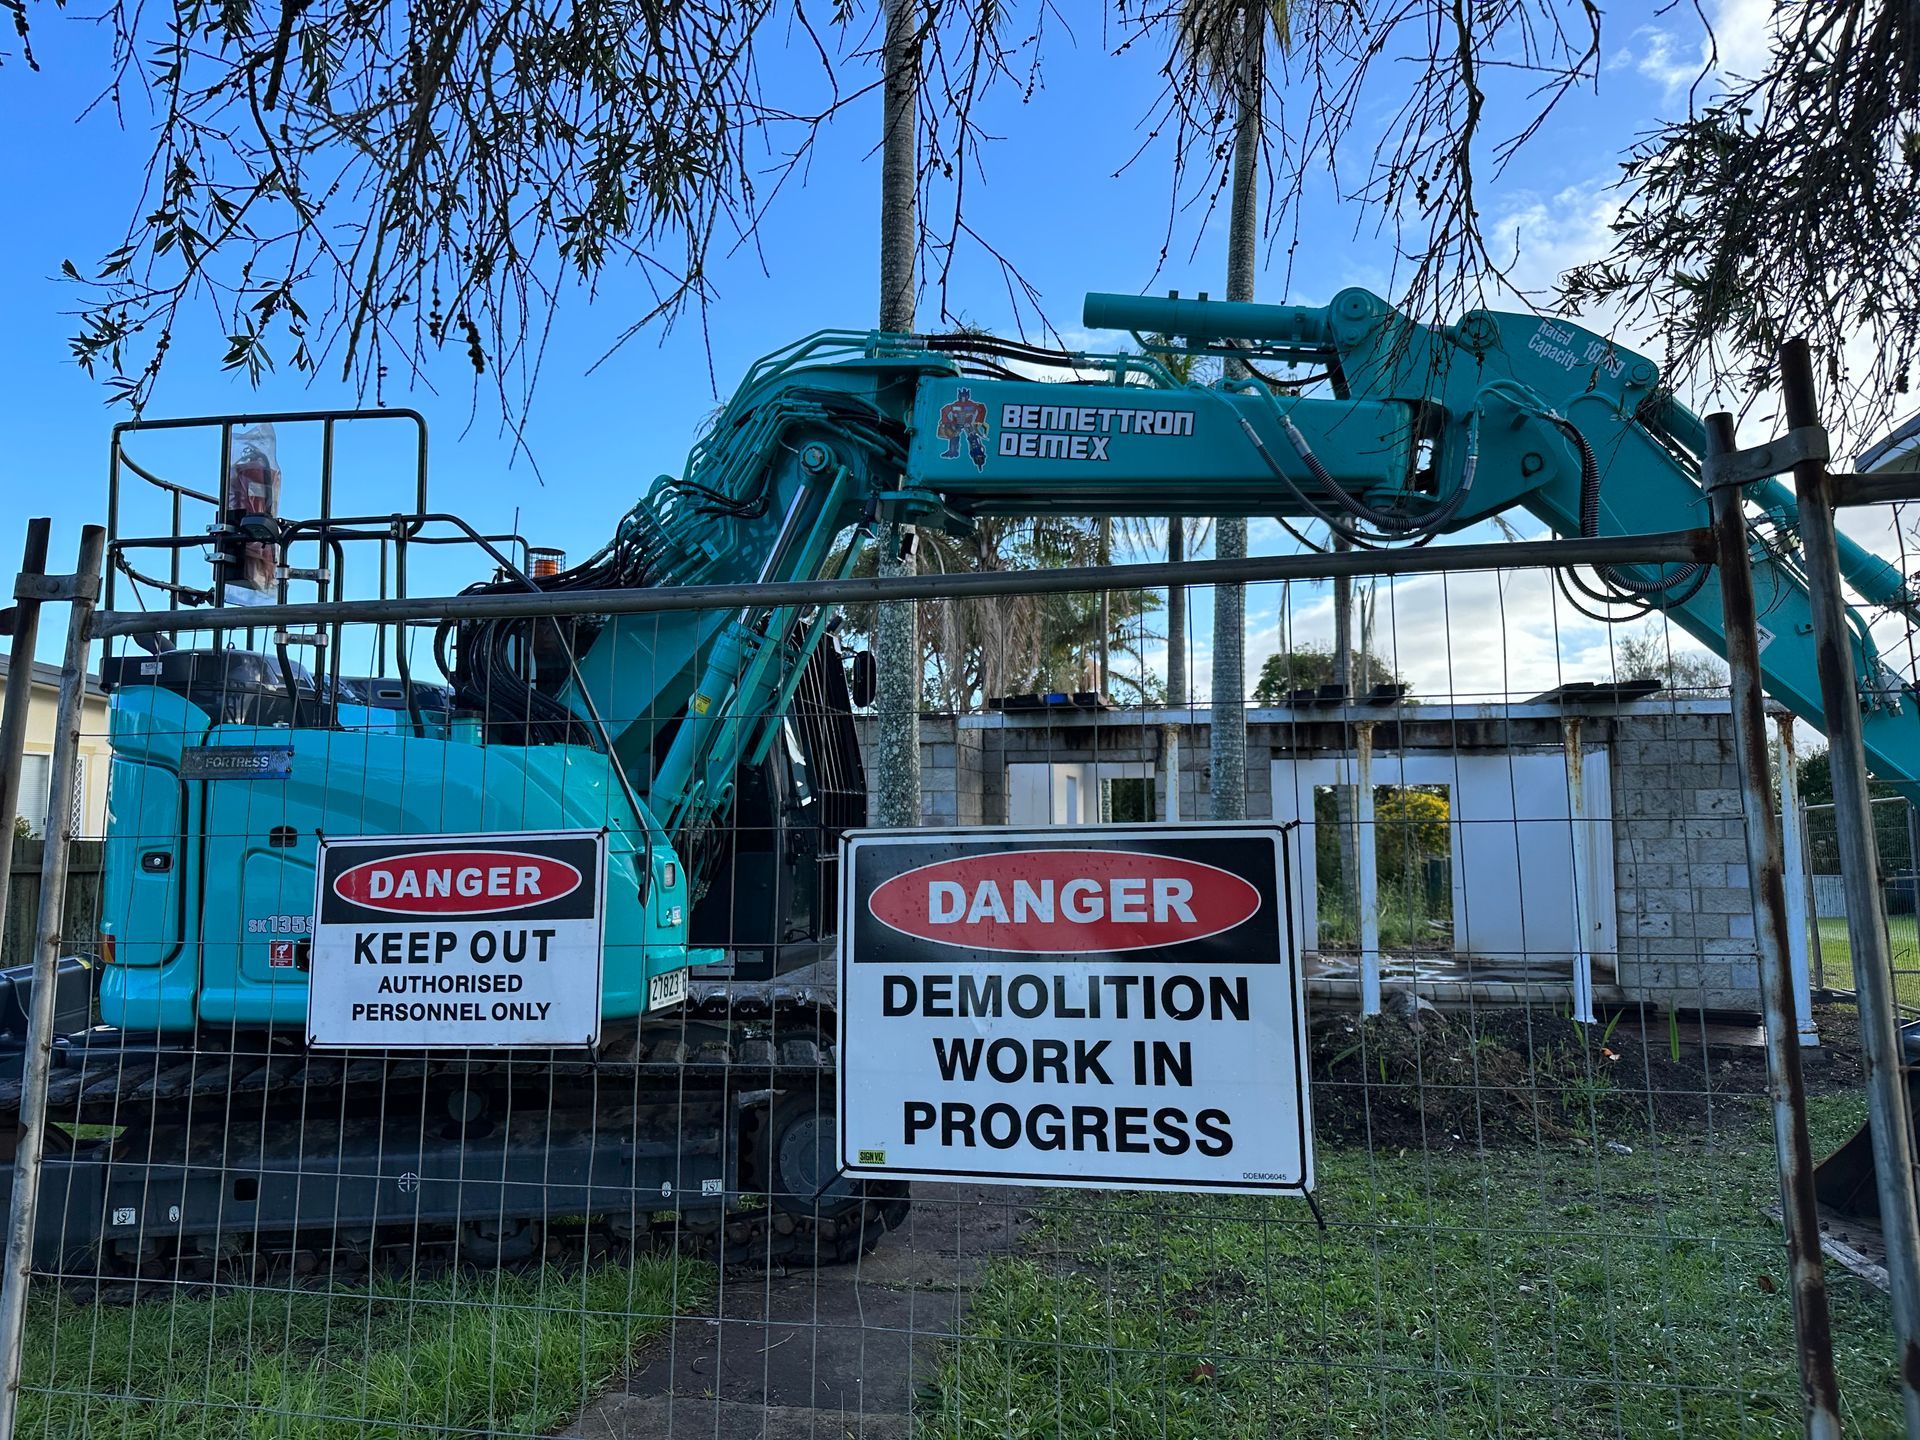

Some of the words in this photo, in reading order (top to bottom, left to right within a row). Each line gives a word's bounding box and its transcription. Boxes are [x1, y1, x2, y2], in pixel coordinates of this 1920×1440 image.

[1537, 318, 1575, 346] Rated
[1528, 333, 1579, 371] Capacity
[1001, 404, 1194, 436] BENNETTRON
[999, 432, 1110, 461] DEMEX
[205, 756, 269, 768] FORTRESS
[369, 866, 541, 899] DANGER
[928, 878, 1198, 924] DANGER
[354, 931, 457, 964] KEEP
[470, 929, 556, 963] OUT
[378, 974, 523, 994] AUTHORISED
[882, 974, 1250, 1021] DEMOLITION
[352, 1003, 487, 1022] PERSONNEL
[491, 1002, 552, 1021] ONLY
[932, 1037, 1114, 1085] WORK
[1133, 1040, 1193, 1087] IN
[903, 1101, 1234, 1157] PROGRESS
[860, 1151, 873, 1161] SIGN
[874, 1152, 884, 1161] VIZ
